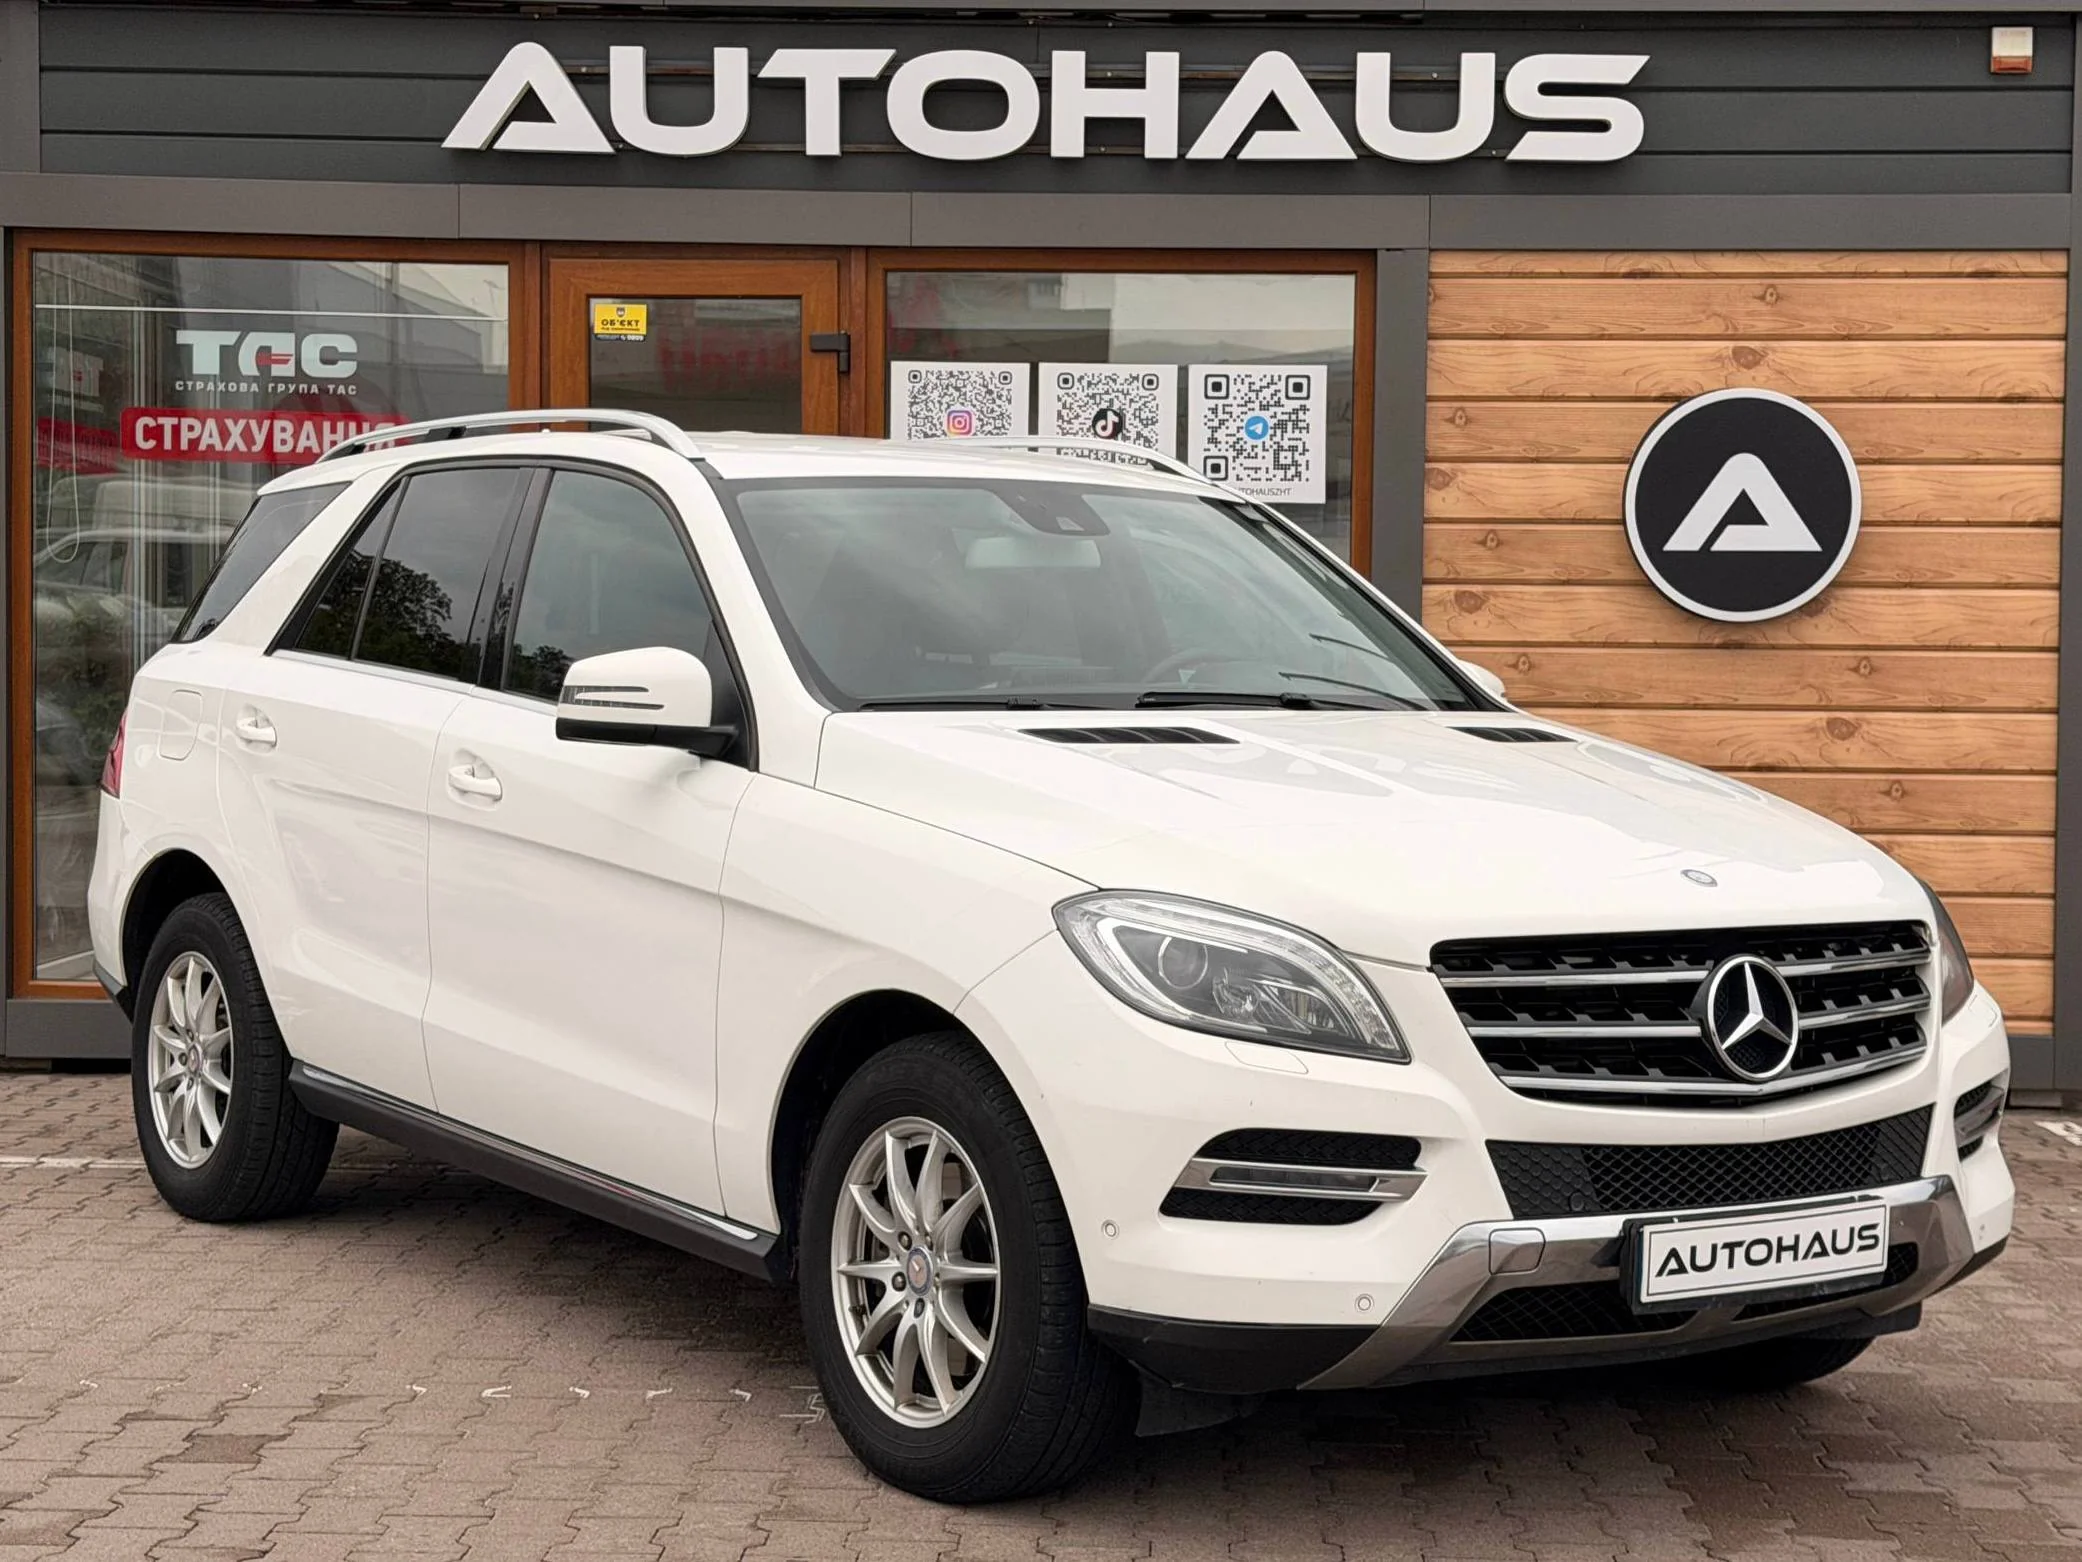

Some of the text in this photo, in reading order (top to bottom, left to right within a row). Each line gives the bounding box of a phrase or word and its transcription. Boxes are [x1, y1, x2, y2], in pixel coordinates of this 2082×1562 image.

[440, 41, 1650, 164] AUTOHAUS
[176, 329, 358, 379] ТАС
[175, 380, 358, 396] СТРАХОВА ГРУПА ТАС
[1654, 1222, 1880, 1278] AUTOHAUS
